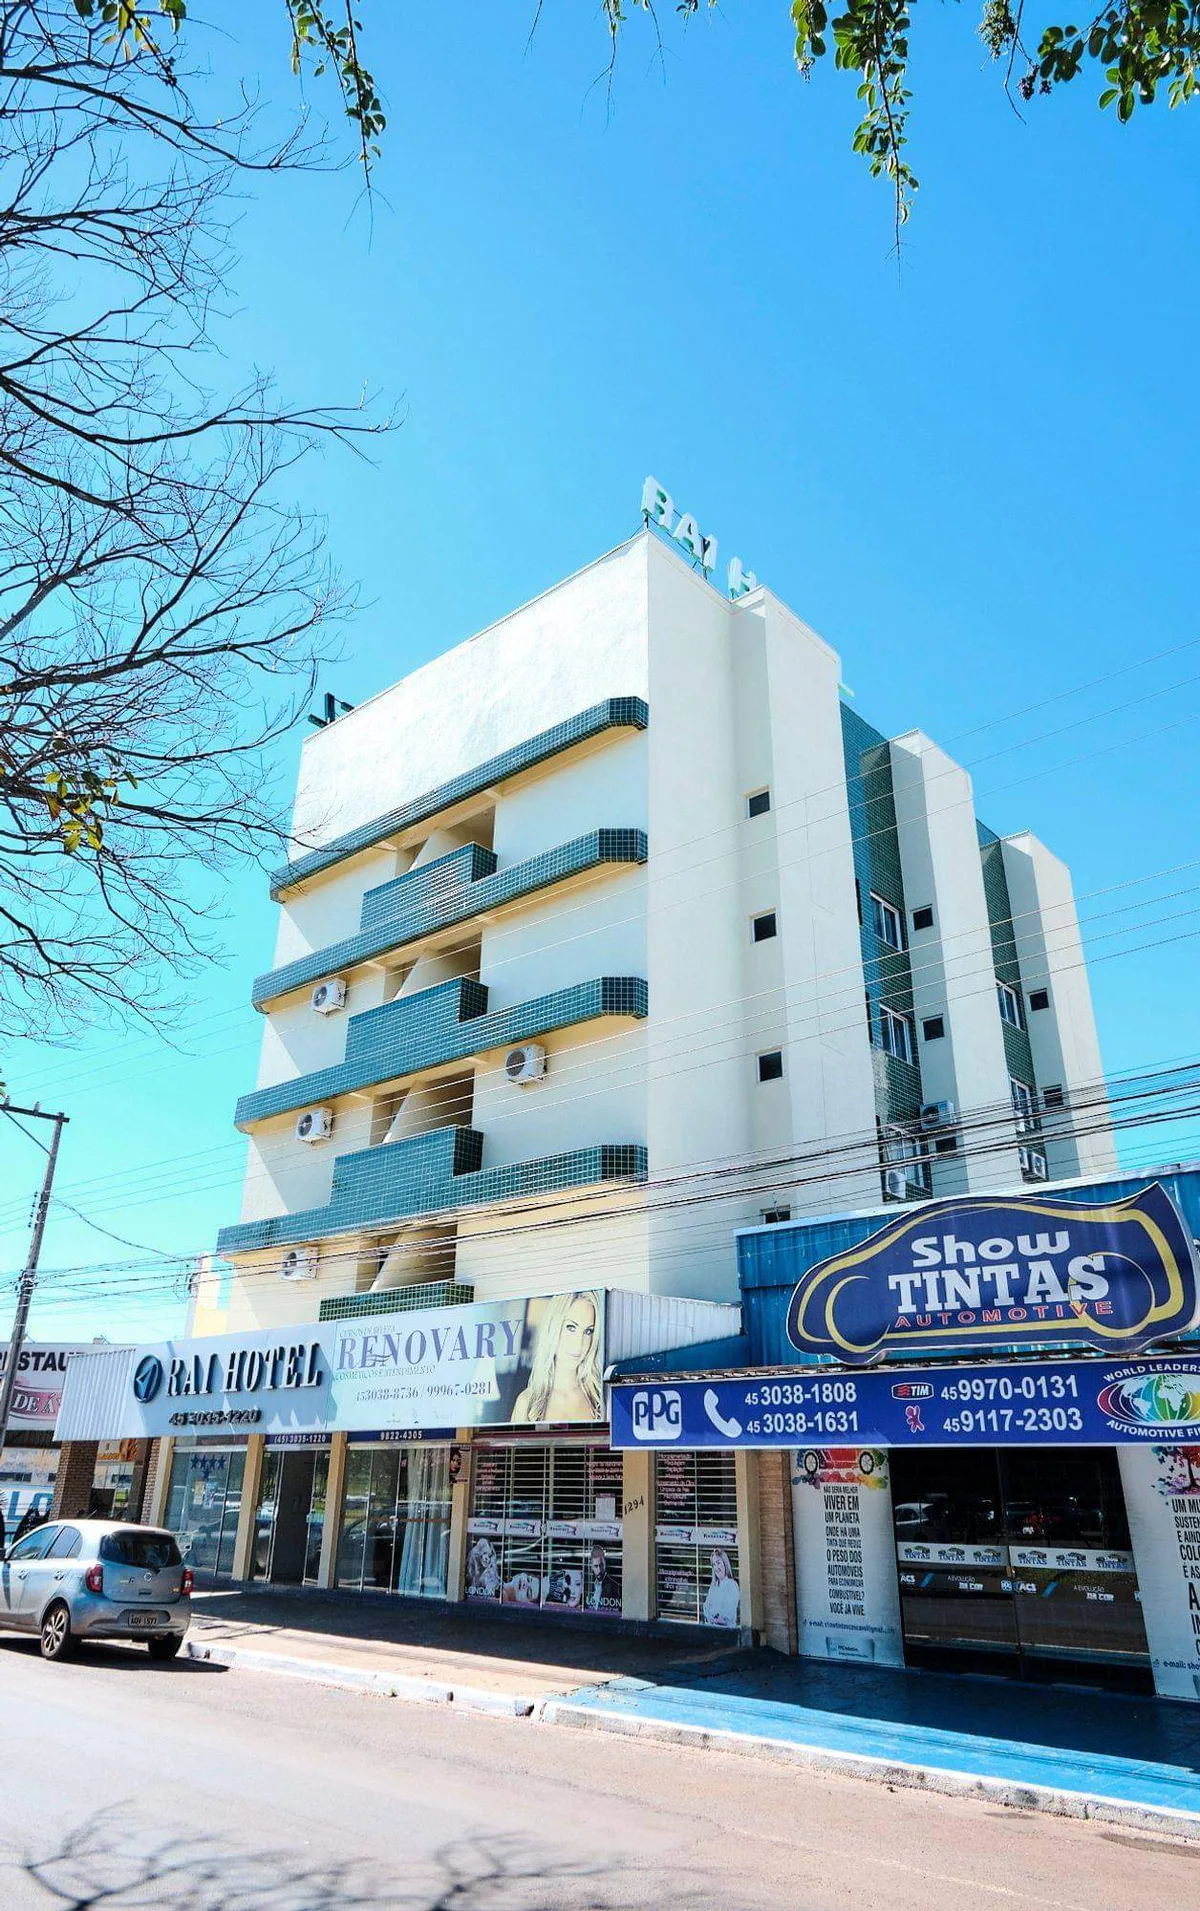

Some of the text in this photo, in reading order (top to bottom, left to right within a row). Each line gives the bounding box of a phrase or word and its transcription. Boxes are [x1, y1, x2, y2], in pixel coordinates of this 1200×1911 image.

[641, 475, 718, 573] RAI
[911, 1230, 1070, 1268] Show
[888, 1255, 1109, 1314] TINTAS
[895, 1301, 1113, 1328] AUTOMOTIVE
[336, 1319, 523, 1371] RENOVARY
[166, 1342, 323, 1397] RAI HOTEL
[1103, 1365, 1146, 1382] WORLD
[745, 1382, 857, 1406] 45 3038-1808
[911, 1375, 1079, 1401] TIM 45 9970-0131
[12, 1393, 39, 1412] DE
[634, 1391, 680, 1431] PPG
[747, 1411, 859, 1434] 45 3038-1631
[943, 1407, 1083, 1433] 45 9117-2303
[1106, 1420, 1185, 1438] AUTOMOTIVE
[289, 1434, 326, 1443] 3035-1220
[823, 1495, 860, 1511] VIVER EM
[1171, 1498, 1187, 1513] UM
[825, 1511, 860, 1524] UM PLANETA
[826, 1526, 839, 1537] ONDE
[848, 1527, 861, 1538] UMA
[1177, 1530, 1183, 1543] E
[826, 1549, 863, 1564] O PESO DOS
[1018, 1557, 1047, 1565] TINTAS
[1056, 1558, 1087, 1567] TINTAS
[828, 1577, 838, 1586] PARA
[585, 1595, 622, 1607] LONDON
